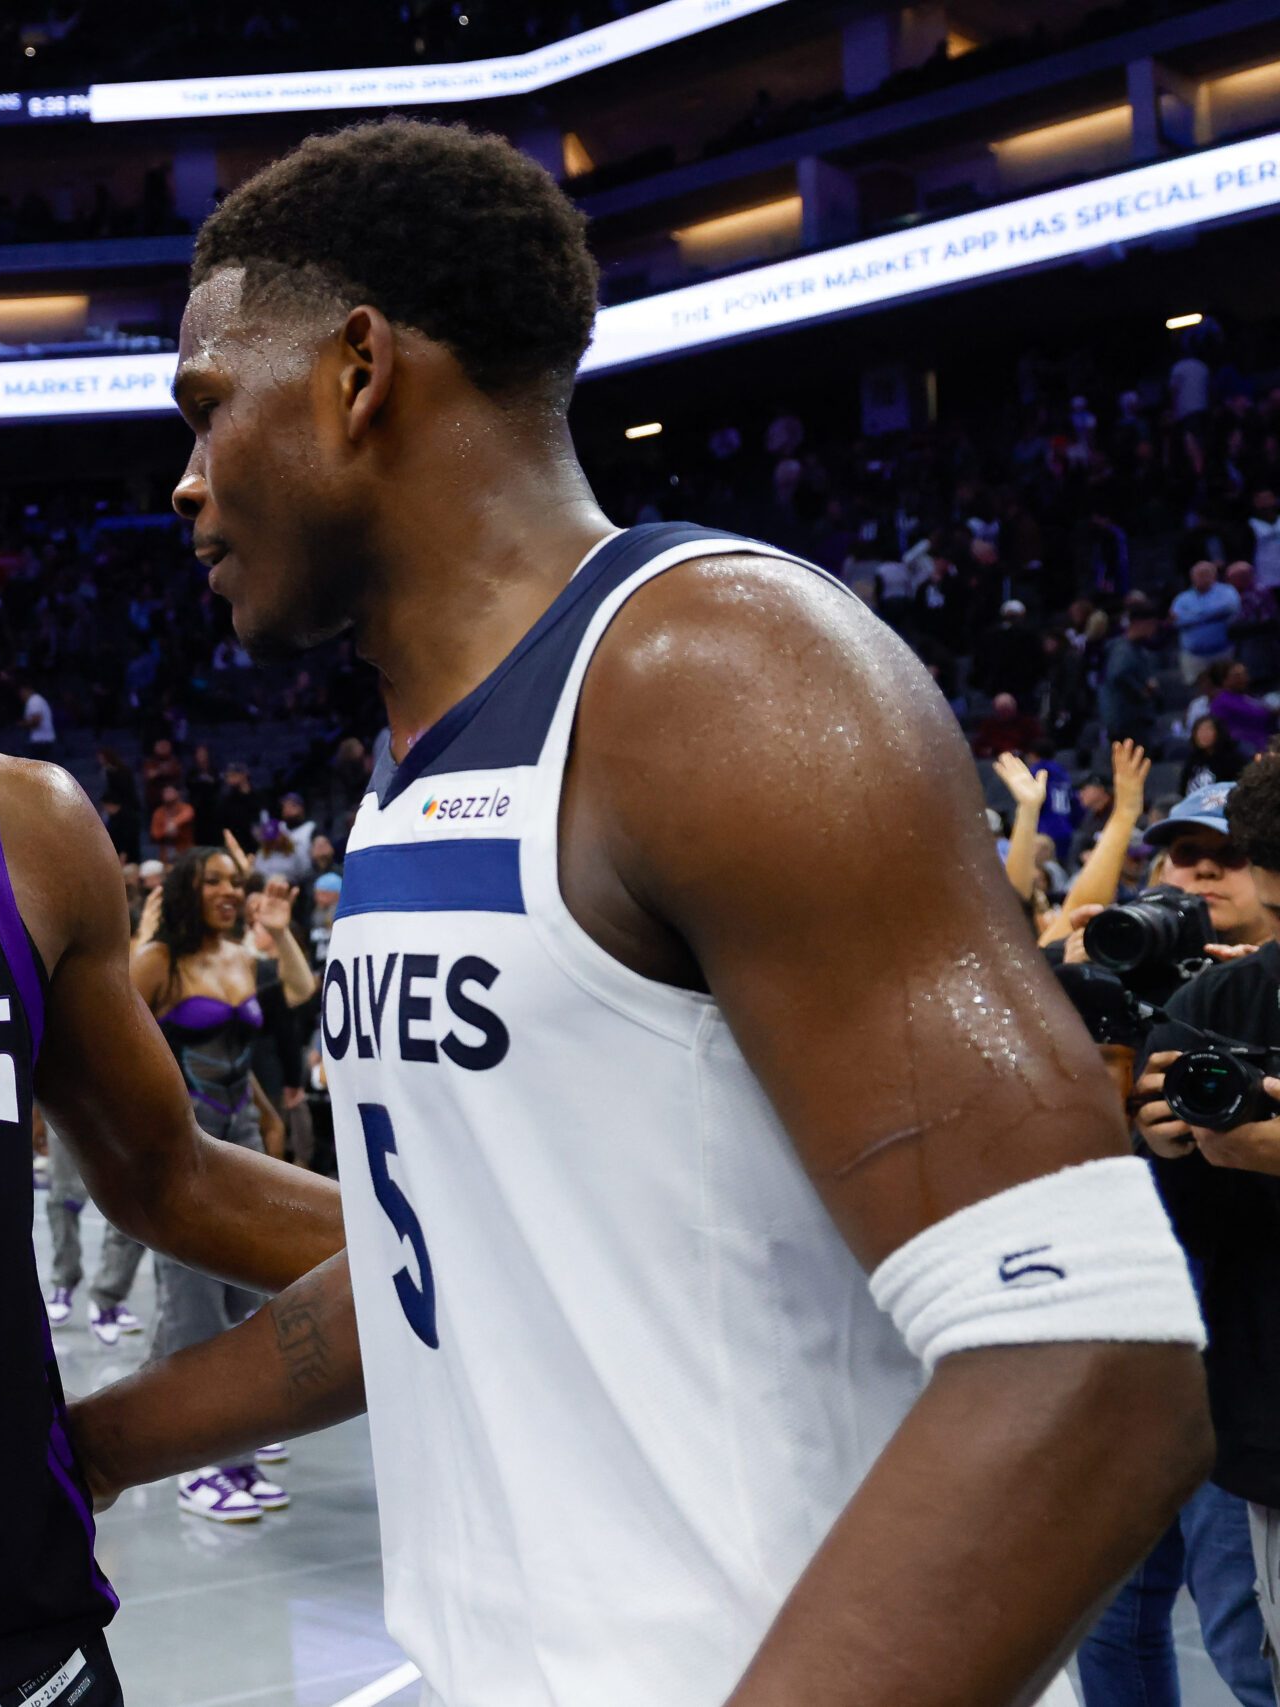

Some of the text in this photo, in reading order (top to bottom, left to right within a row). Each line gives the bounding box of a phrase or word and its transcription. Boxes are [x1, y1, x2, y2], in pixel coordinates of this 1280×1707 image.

[672, 308, 712, 328] THE
[725, 277, 816, 315] POWER
[825, 246, 934, 290] MARKET
[943, 230, 998, 261] APP
[1006, 212, 1068, 244] HAS
[1075, 180, 1205, 230] SPECIAL
[5, 374, 100, 397] MARKET
[108, 371, 156, 392] APP
[436, 787, 510, 820] sezzle
[357, 1103, 440, 1350] 5
